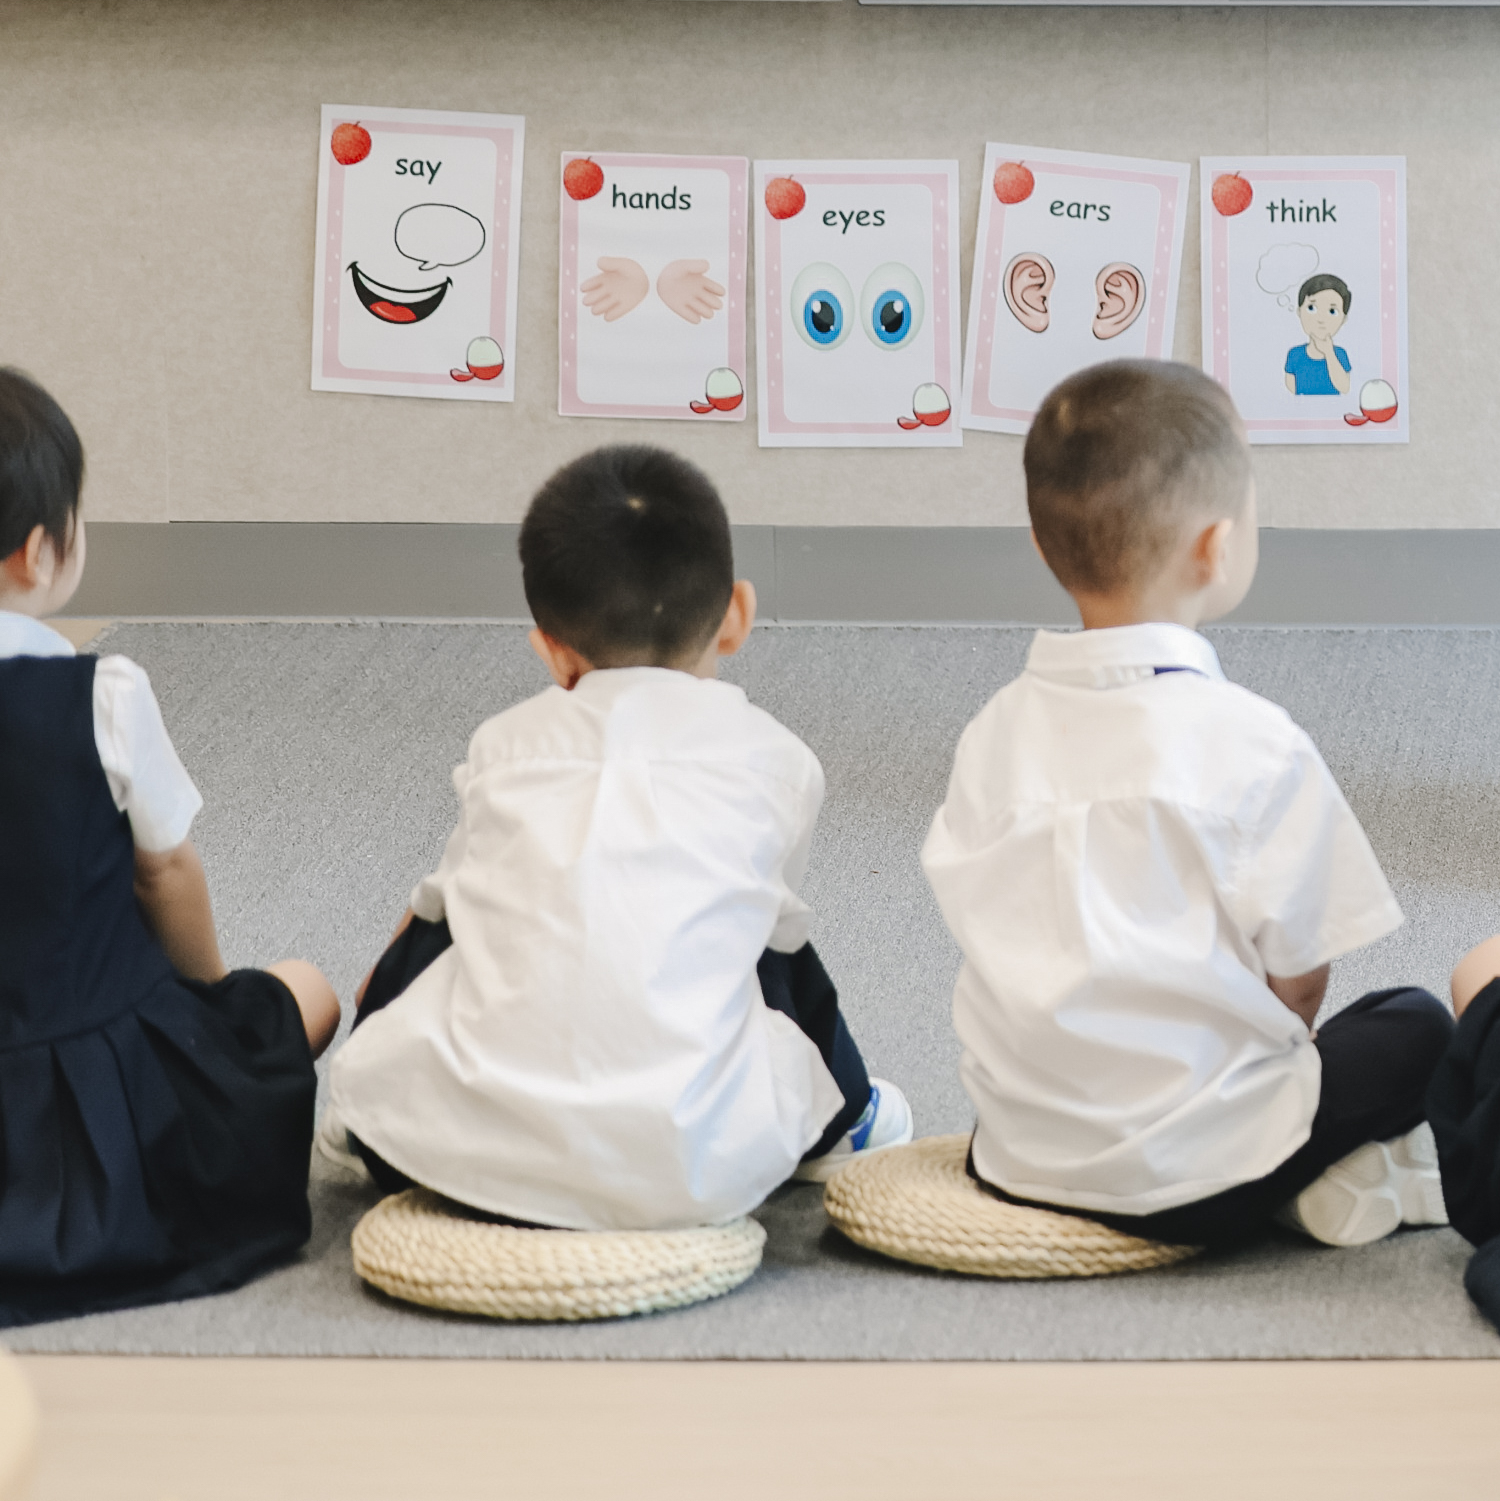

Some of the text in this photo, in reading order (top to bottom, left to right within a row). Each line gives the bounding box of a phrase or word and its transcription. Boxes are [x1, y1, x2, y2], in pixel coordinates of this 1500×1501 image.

[394, 156, 442, 184] say
[611, 184, 692, 211] hands
[1049, 198, 1111, 223] ears
[1266, 198, 1338, 224] think
[822, 206, 886, 234] eyes
